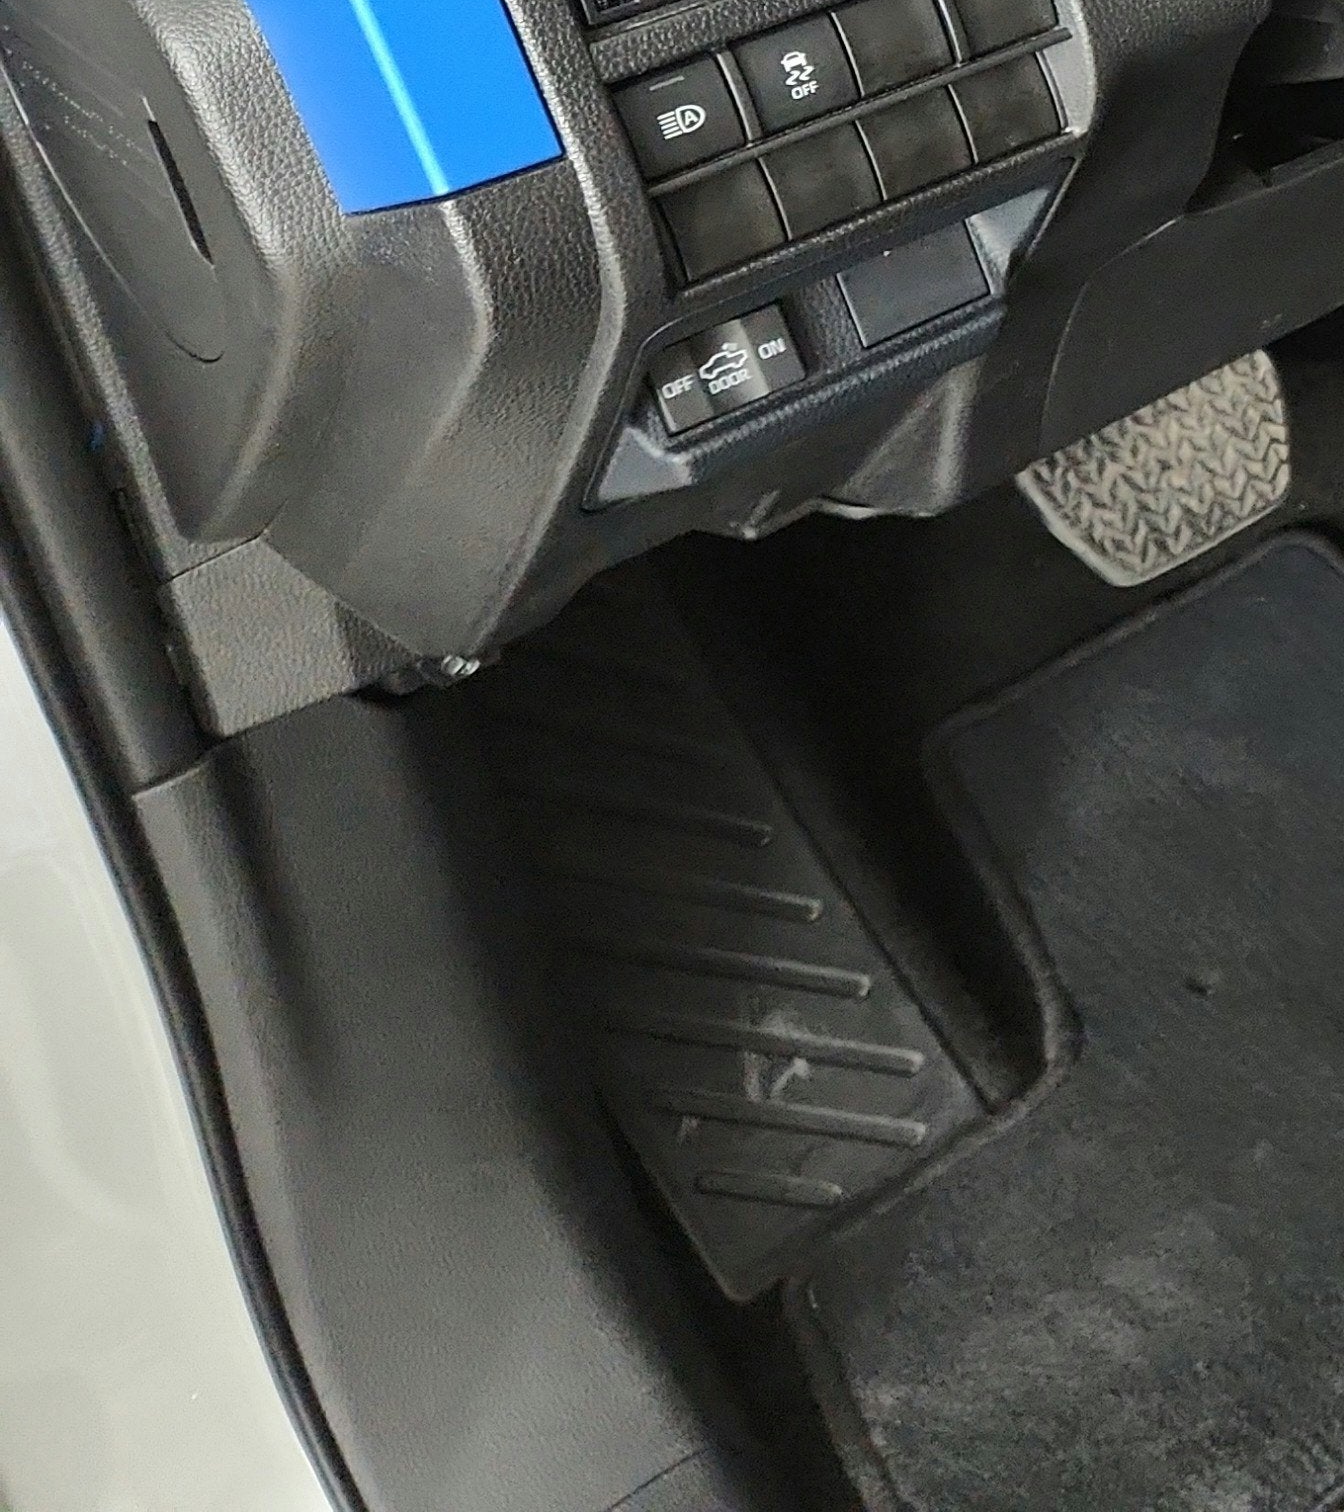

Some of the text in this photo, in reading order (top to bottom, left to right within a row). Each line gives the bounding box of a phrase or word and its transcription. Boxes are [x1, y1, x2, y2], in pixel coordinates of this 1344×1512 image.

[791, 80, 820, 100] OFF
[757, 337, 787, 360] ON
[661, 374, 696, 400] OFF
[708, 368, 753, 395] DOOR
